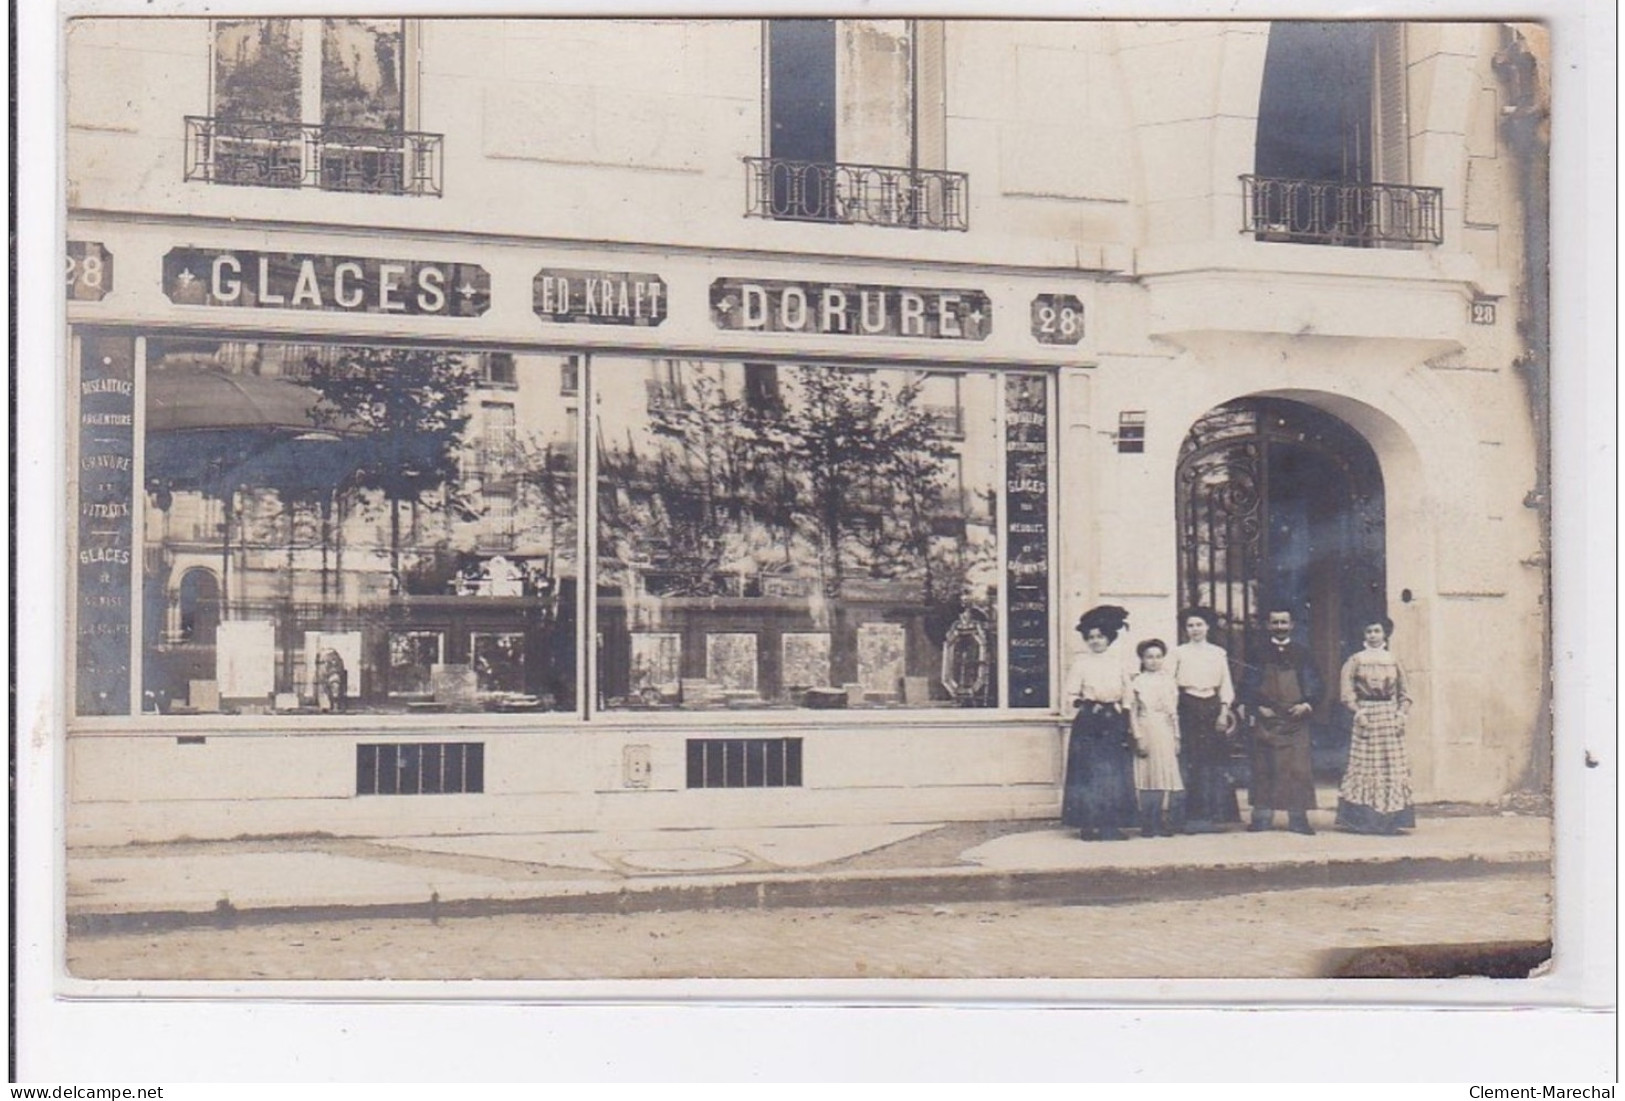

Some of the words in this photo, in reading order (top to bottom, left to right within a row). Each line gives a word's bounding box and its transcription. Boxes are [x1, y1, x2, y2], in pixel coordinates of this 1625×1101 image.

[212, 254, 445, 312] GLACES
[542, 276, 569, 315] ED
[585, 278, 660, 318] KRAFT
[742, 284, 962, 337] DORURE
[1474, 305, 1493, 323] 28
[1039, 307, 1076, 335] 28
[82, 413, 132, 426] ARGENTURE
[81, 454, 131, 471] GRAVURE
[82, 501, 129, 518] VITRAUX
[80, 547, 130, 565] GLACES
